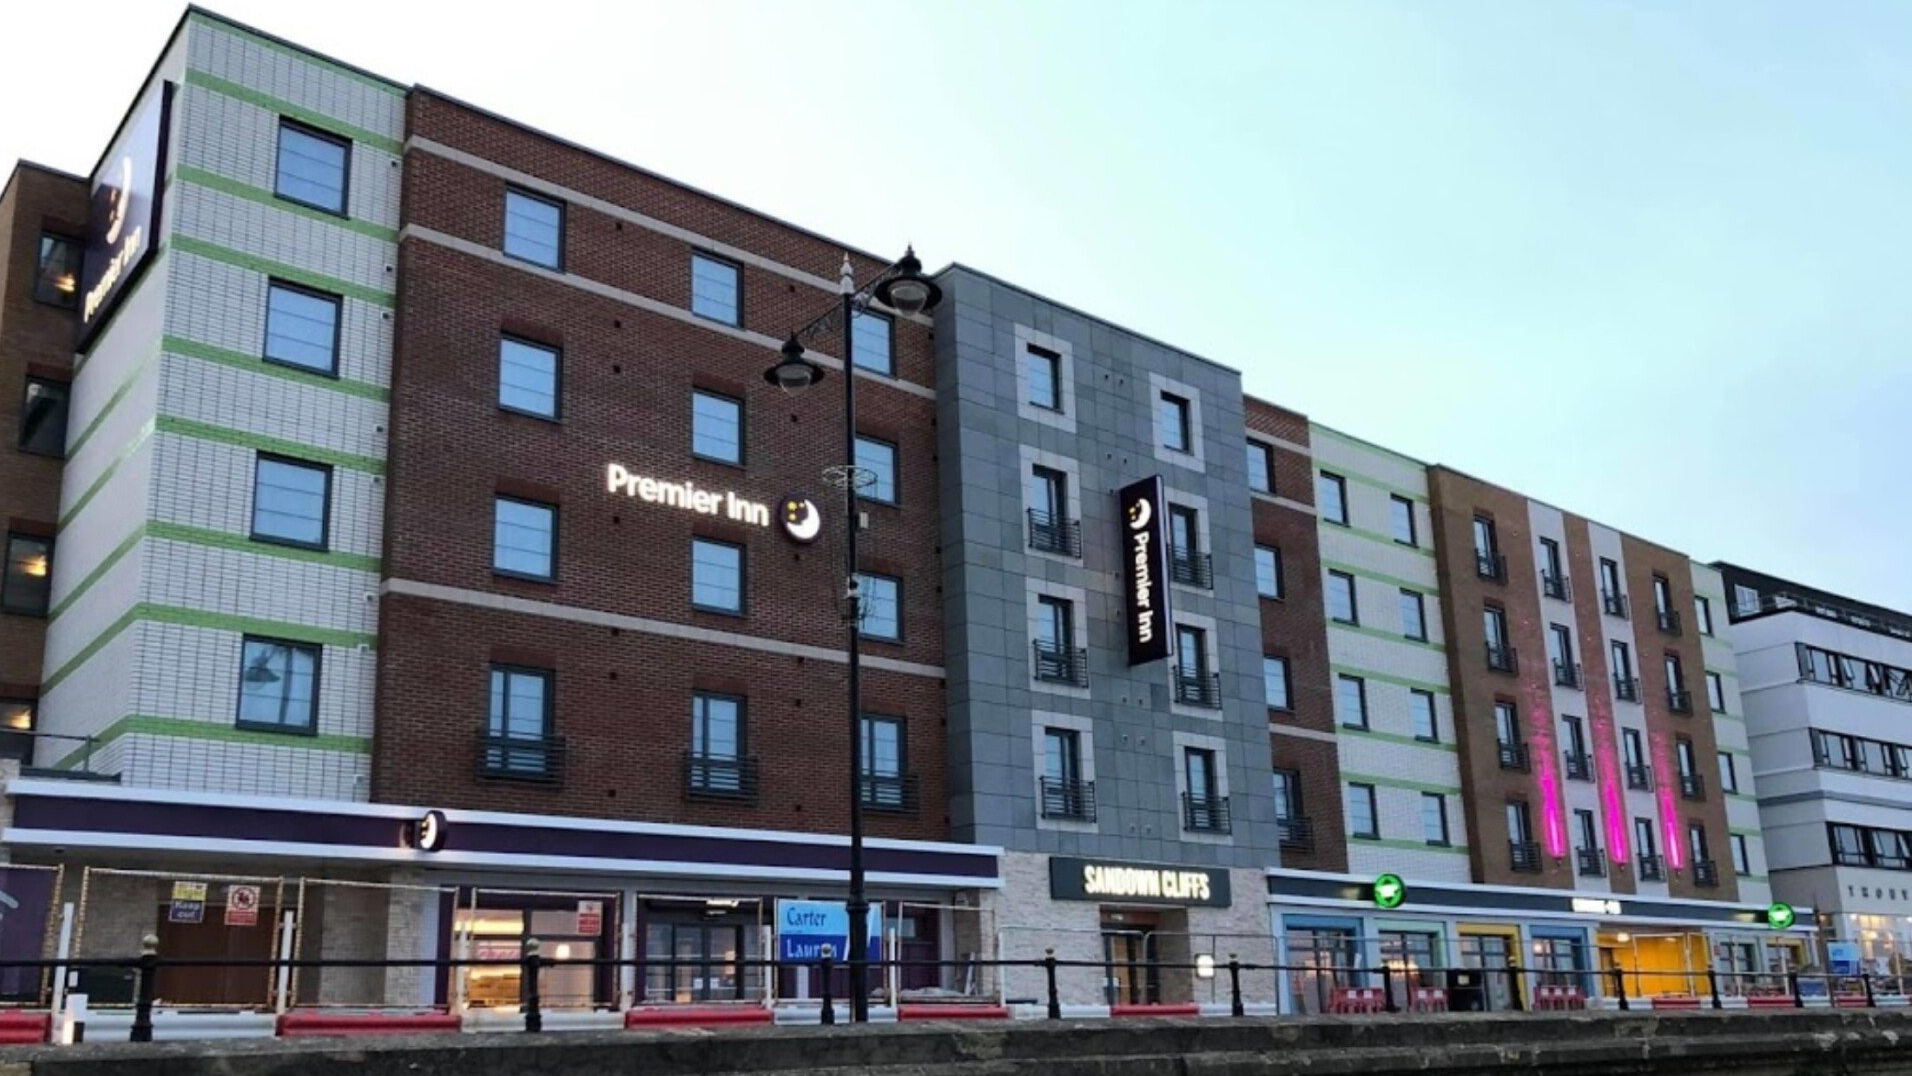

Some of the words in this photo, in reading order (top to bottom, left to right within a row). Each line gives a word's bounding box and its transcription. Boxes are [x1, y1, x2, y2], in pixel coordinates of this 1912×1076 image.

[607, 463, 724, 515] Premier
[727, 491, 770, 527] Inn
[1133, 530, 1154, 609] Premier
[1137, 610, 1154, 643] Inn
[1084, 864, 1160, 898] SANDOWN
[1160, 869, 1211, 901] CLIFFS
[787, 907, 827, 927] Carter
[787, 938, 838, 959] Laurn
